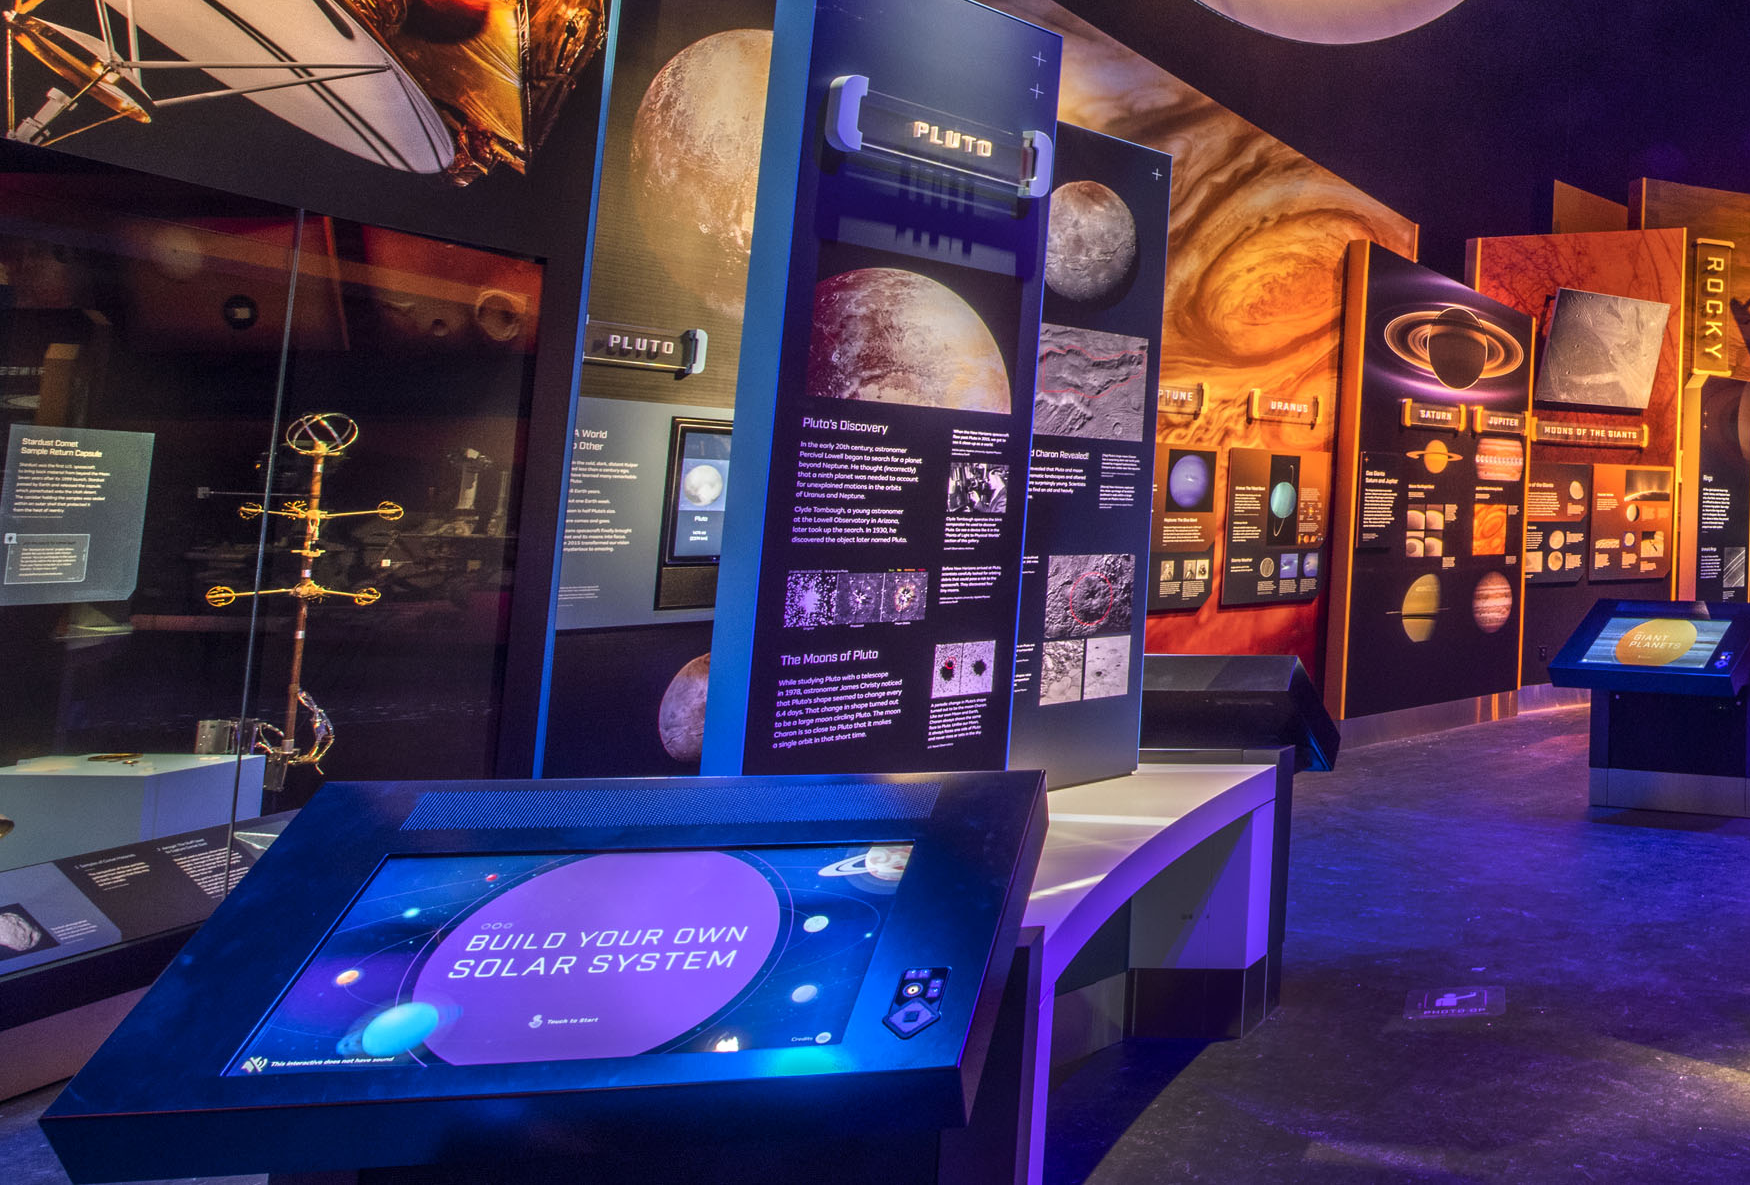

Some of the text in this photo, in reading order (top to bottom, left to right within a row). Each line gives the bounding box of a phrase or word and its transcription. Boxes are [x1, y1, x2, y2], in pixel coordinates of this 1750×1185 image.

[912, 121, 992, 158] PLUTO
[1705, 256, 1725, 359] ROCKY
[608, 334, 674, 354] PLUTO
[1158, 390, 1192, 401] PTUNE
[1271, 400, 1308, 413] URANUS
[1420, 409, 1452, 420] SATURN
[803, 418, 888, 435] Pluto's Discovery
[1488, 417, 1519, 426] JUPITER
[582, 429, 607, 439] World
[1544, 426, 1637, 439] MOONS OF THE GIANTS
[22, 437, 78, 447] Stardust Comet
[579, 441, 604, 451] Other
[819, 442, 834, 450] early
[851, 444, 874, 453] century,
[21, 447, 102, 458] Sample Return Capsule
[1036, 449, 1058, 458] Charon
[813, 507, 846, 515] Tombaugh,
[1629, 641, 1682, 649] PLANETS
[780, 649, 879, 666] The Moons of Pluto
[798, 677, 824, 687] studying
[825, 675, 841, 683] Pluto
[861, 672, 889, 681] telescope
[465, 925, 749, 952] BUILD YOUR OWN
[448, 950, 738, 979] SOLAR SYSTEM
